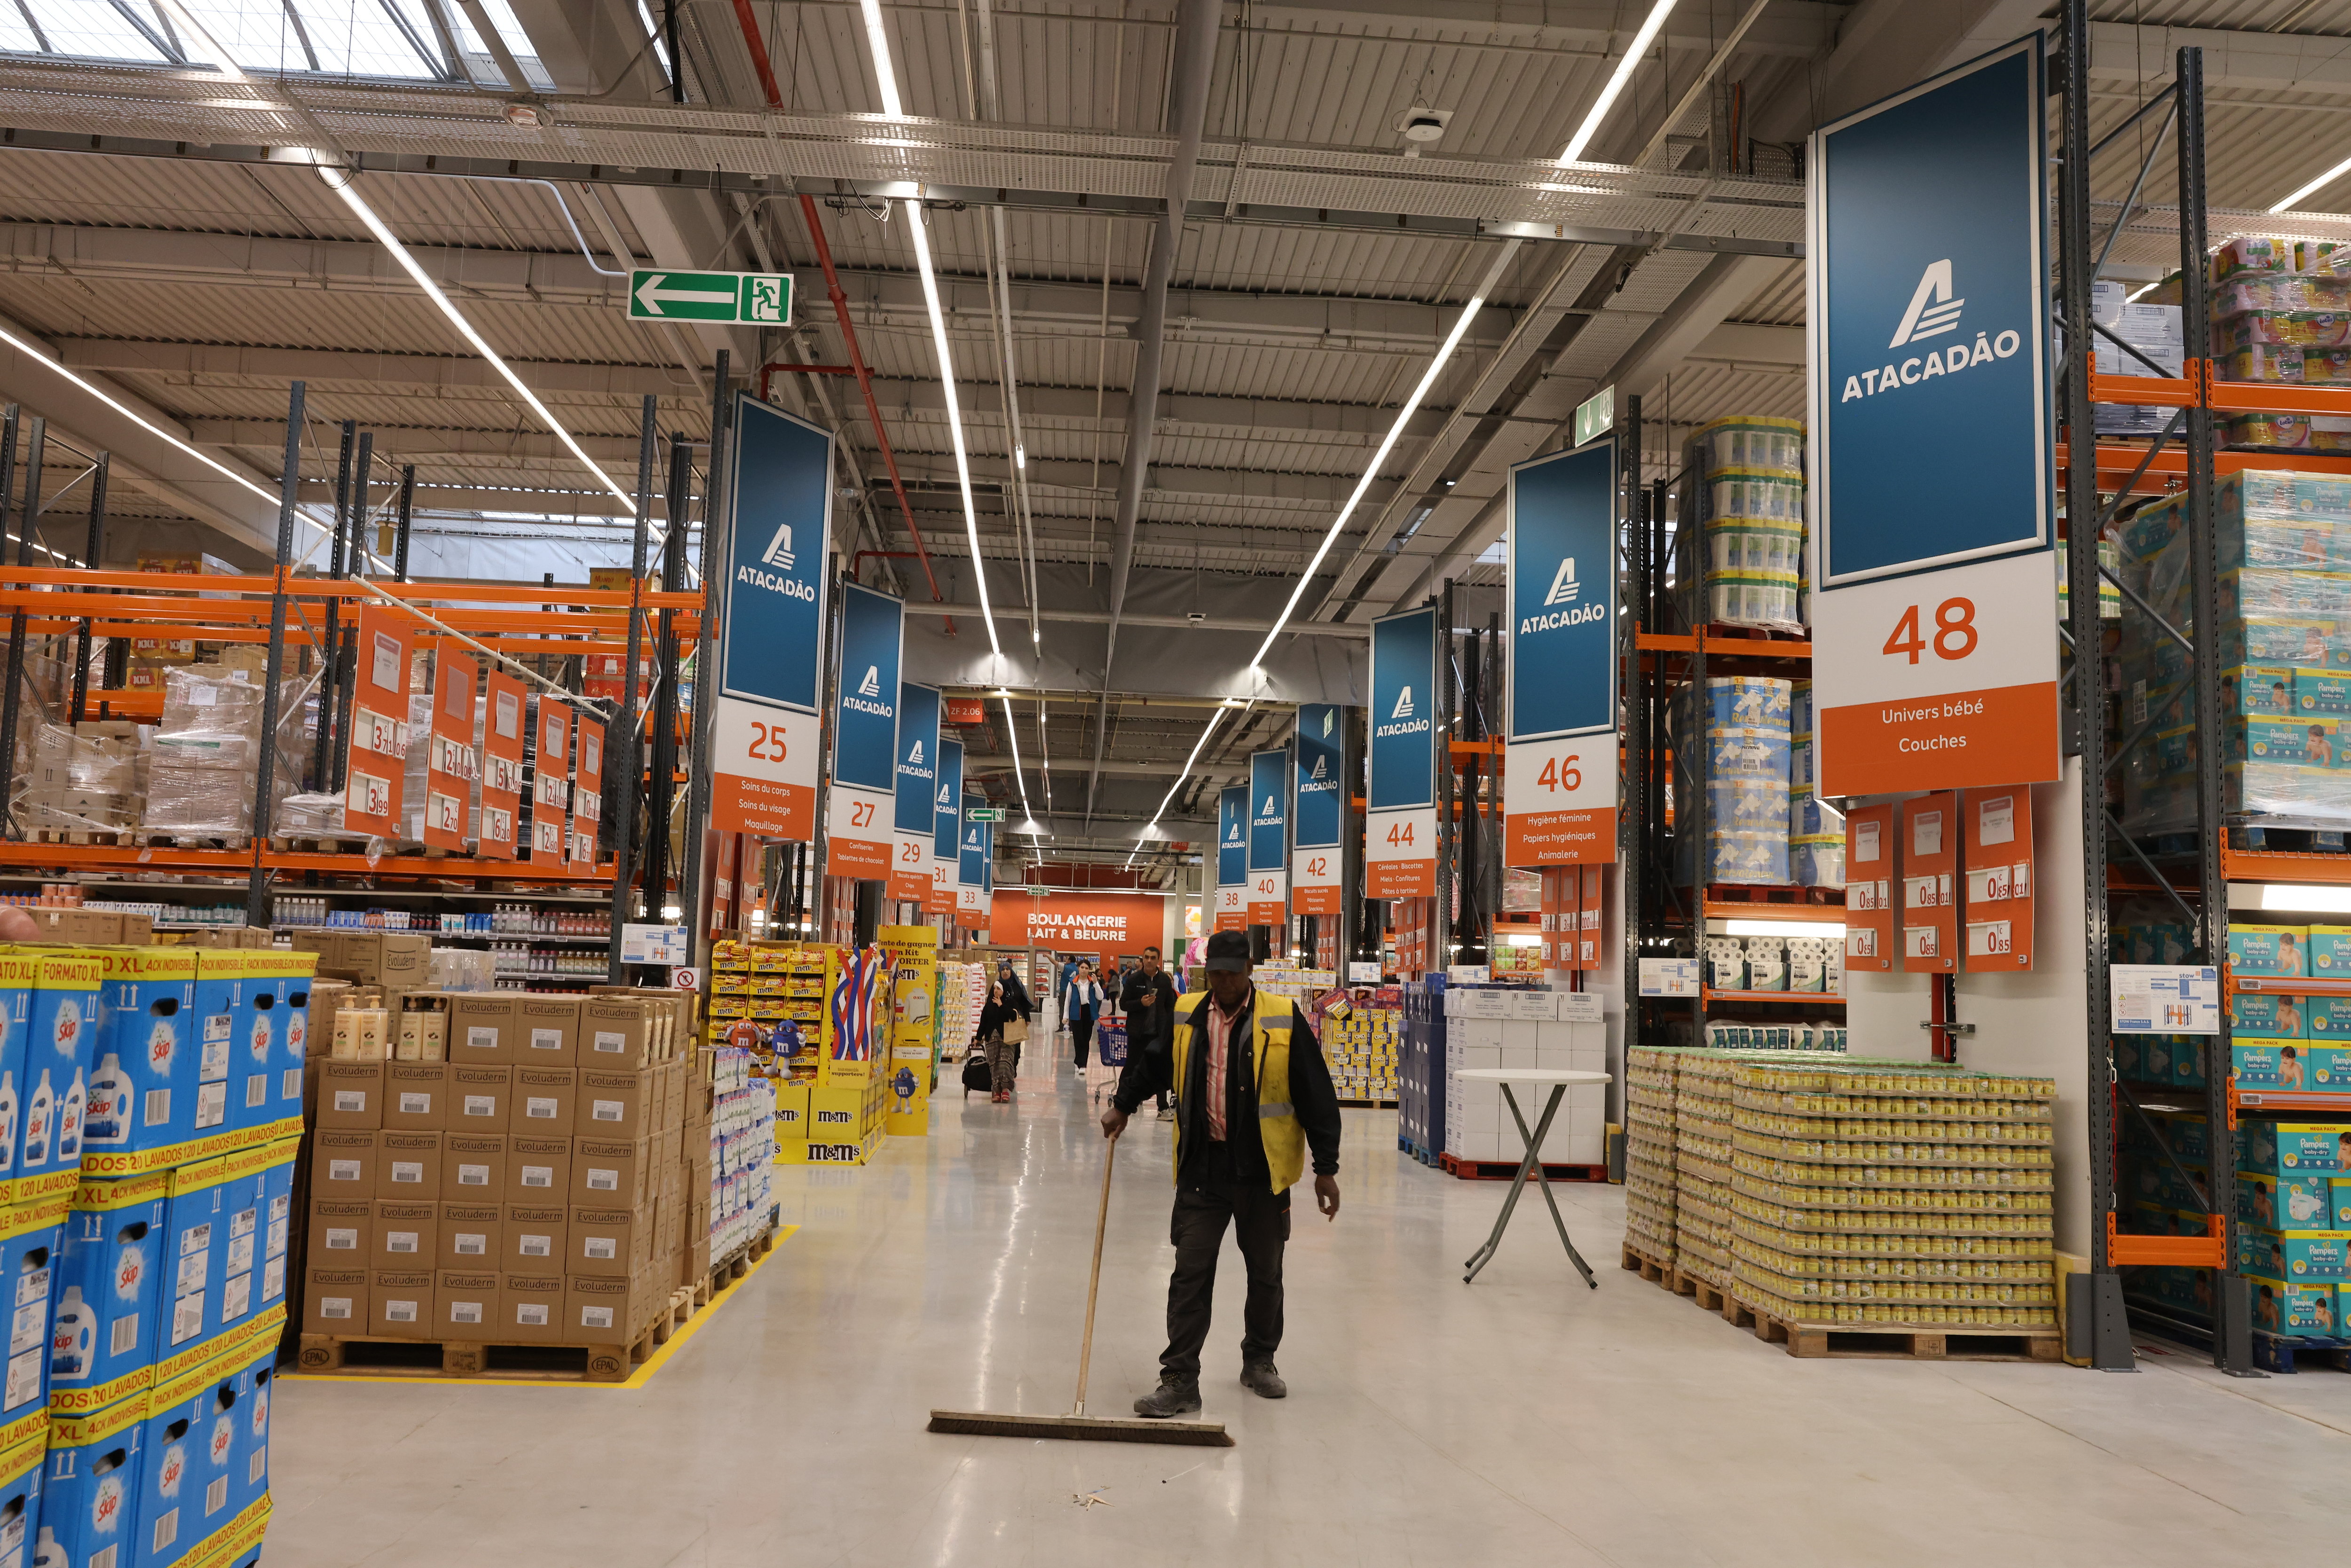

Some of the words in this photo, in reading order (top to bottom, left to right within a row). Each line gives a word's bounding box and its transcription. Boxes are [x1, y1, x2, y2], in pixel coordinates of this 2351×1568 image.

[1842, 330, 2020, 403] ATACADÃO
[737, 565, 815, 602] ATACADÃO
[1520, 603, 1605, 635] ATACADÃO
[1883, 597, 1978, 665] 48
[843, 696, 892, 717] ATACADÃO
[1882, 707, 1939, 724] Univers
[1943, 698, 1983, 717] bébé
[1376, 718, 1429, 738] ATACADÃO
[749, 722, 787, 763] 25
[1899, 734, 1967, 752] Couches
[897, 764, 933, 779] ATACADÃO
[1538, 755, 1581, 792] 46
[741, 780, 760, 792] Soins
[761, 784, 770, 793] du
[772, 788, 790, 797] corps
[1300, 779, 1338, 793] ATACADÃO
[739, 799, 757, 810] Soins
[759, 803, 768, 812] du
[769, 805, 791, 816] visage
[852, 801, 875, 827] 27
[744, 819, 783, 833] Maquillage
[1254, 816, 1283, 826] ATACADÃO
[1528, 815, 1557, 827] Hygiène
[1559, 814, 1592, 823] féminine
[1387, 822, 1414, 847] 44
[1523, 834, 1550, 844] Papiers
[1551, 832, 1596, 843] hygiéniques
[849, 842, 874, 851] Confiseries
[1222, 840, 1246, 849] ATACADÃO
[837, 853, 858, 862] Tablettes
[902, 843, 920, 863] 29
[1538, 850, 1578, 859] Animalerie
[1307, 858, 1326, 876] 42
[934, 867, 947, 883] 31
[1258, 879, 1274, 894] 40
[965, 891, 975, 904] 33
[1226, 893, 1238, 906] 38
[1028, 913, 1127, 928] BOULANGERIE
[1027, 927, 1057, 939] LAIT
[1060, 929, 1070, 939] &
[1074, 929, 1126, 942] BEURRE
[2243, 938, 2271, 949] Pampers
[119, 957, 144, 973] XL
[200, 960, 215, 970] PACK
[215, 959, 244, 970] INDIVISIBLE
[388, 954, 416, 966] Evoluderm
[43, 964, 88, 982] FORMATO
[89, 963, 101, 982] XL
[461, 1002, 511, 1012] Evoluderm
[590, 1006, 639, 1018] Evoluderm
[329, 1066, 378, 1076] Evoluderm
[457, 1071, 507, 1081] Evoluderm
[183, 1144, 195, 1158] 120
[197, 1138, 229, 1155] LAVADOS
[2300, 1138, 2329, 1149] Pampers
[20, 1180, 34, 1198] 120
[36, 1172, 78, 1194] LAVADOS
[447, 1209, 497, 1219] Evoluderm
[379, 1275, 429, 1285] Evoluderm
[575, 1280, 625, 1292] Evoluderm
[159, 1365, 172, 1379] 120
[174, 1346, 210, 1372] LAVADOS
[305, 1352, 325, 1362] EPAL
[596, 1359, 614, 1370] EPAL
[155, 1394, 171, 1407] PACK
[172, 1375, 205, 1400] INDIVISIBLE
